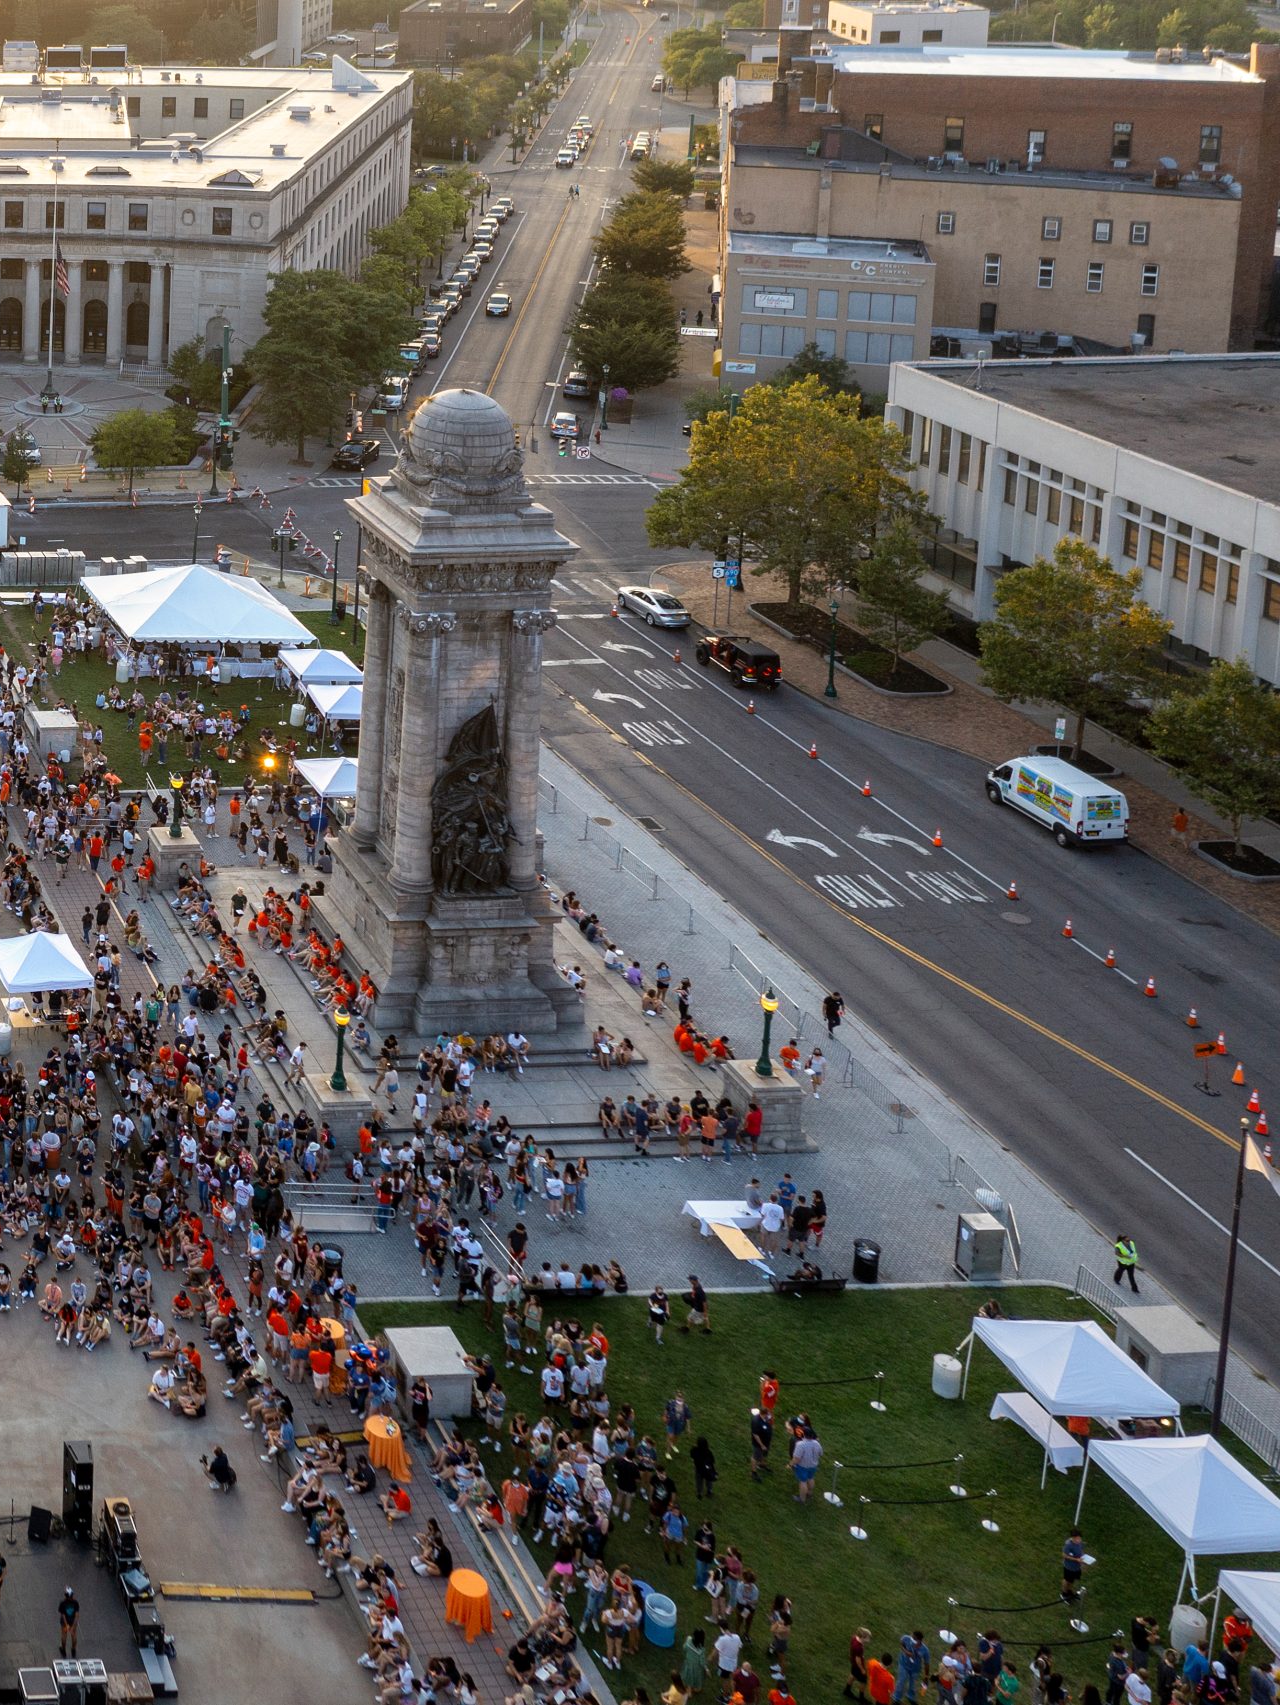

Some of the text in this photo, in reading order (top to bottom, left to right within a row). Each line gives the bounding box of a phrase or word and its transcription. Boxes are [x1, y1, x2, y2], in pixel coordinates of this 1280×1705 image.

[850, 261, 876, 276] C/C
[633, 668, 703, 690] ONLY
[622, 720, 692, 747] ONLY
[814, 874, 905, 909] ONLY
[905, 871, 994, 905] ONLY
